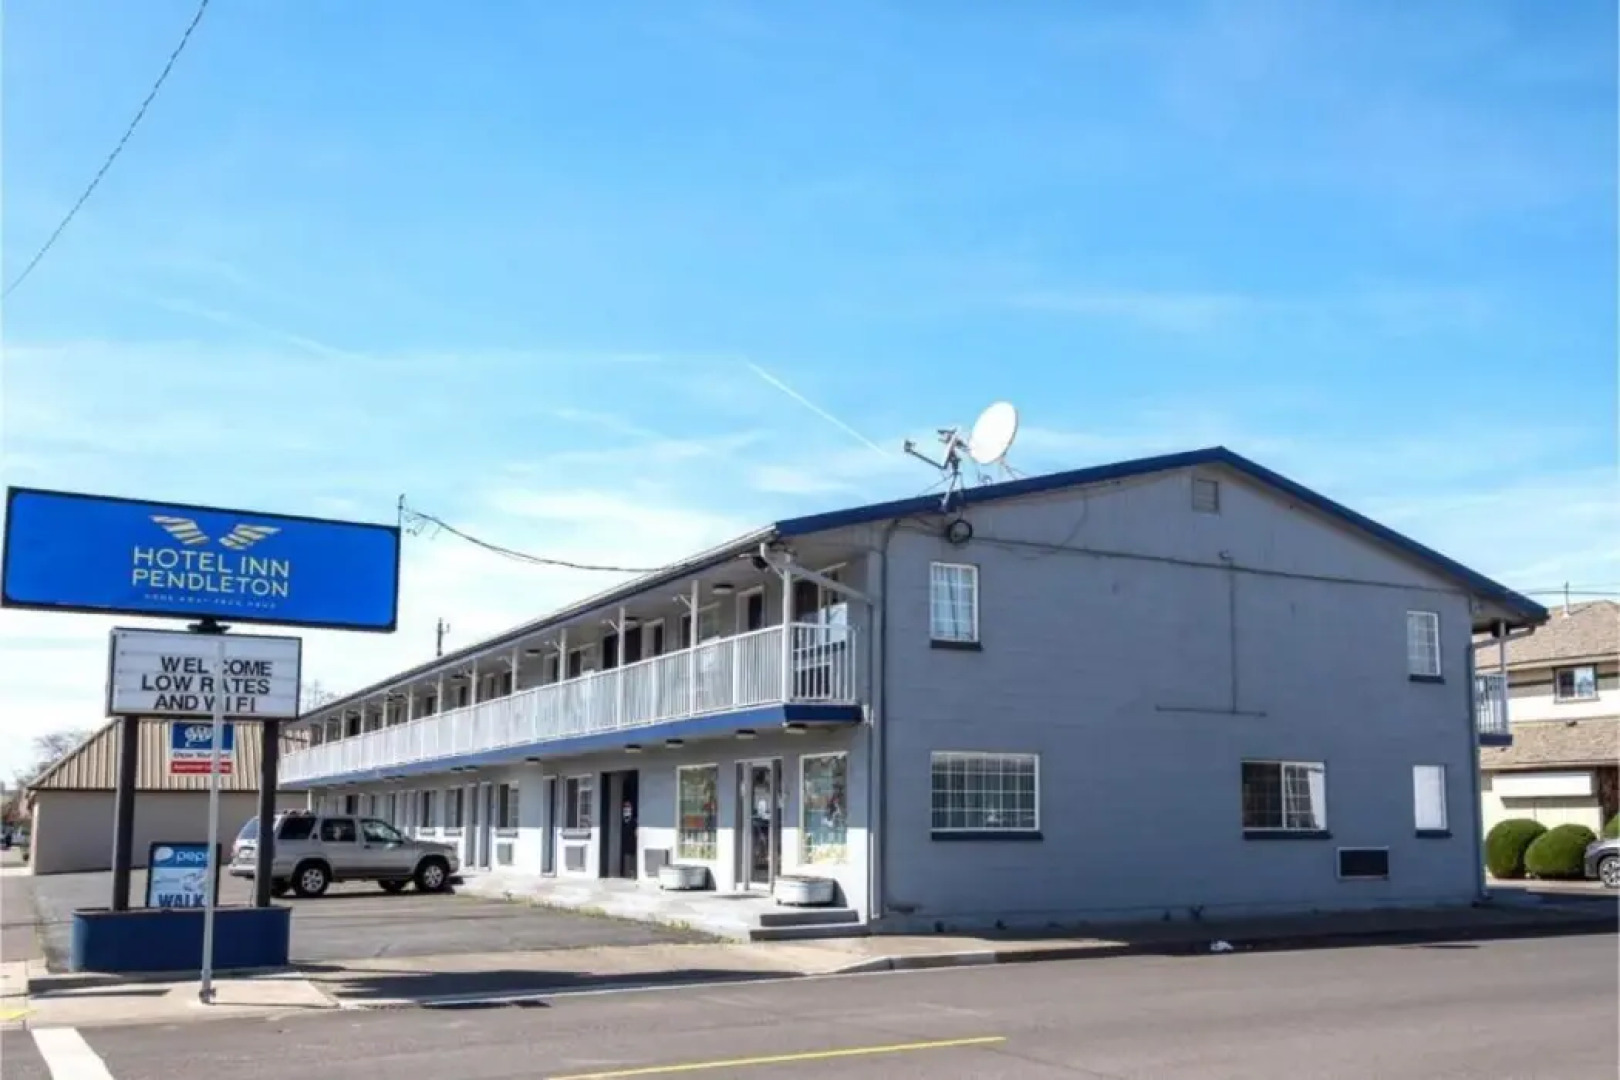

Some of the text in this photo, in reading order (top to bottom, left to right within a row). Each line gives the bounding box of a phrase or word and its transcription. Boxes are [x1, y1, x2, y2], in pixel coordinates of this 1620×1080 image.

[132, 545, 290, 578] HOTEL INN
[132, 568, 289, 597] PENDLETON
[141, 673, 193, 691] LOW
[154, 693, 198, 711] AND
